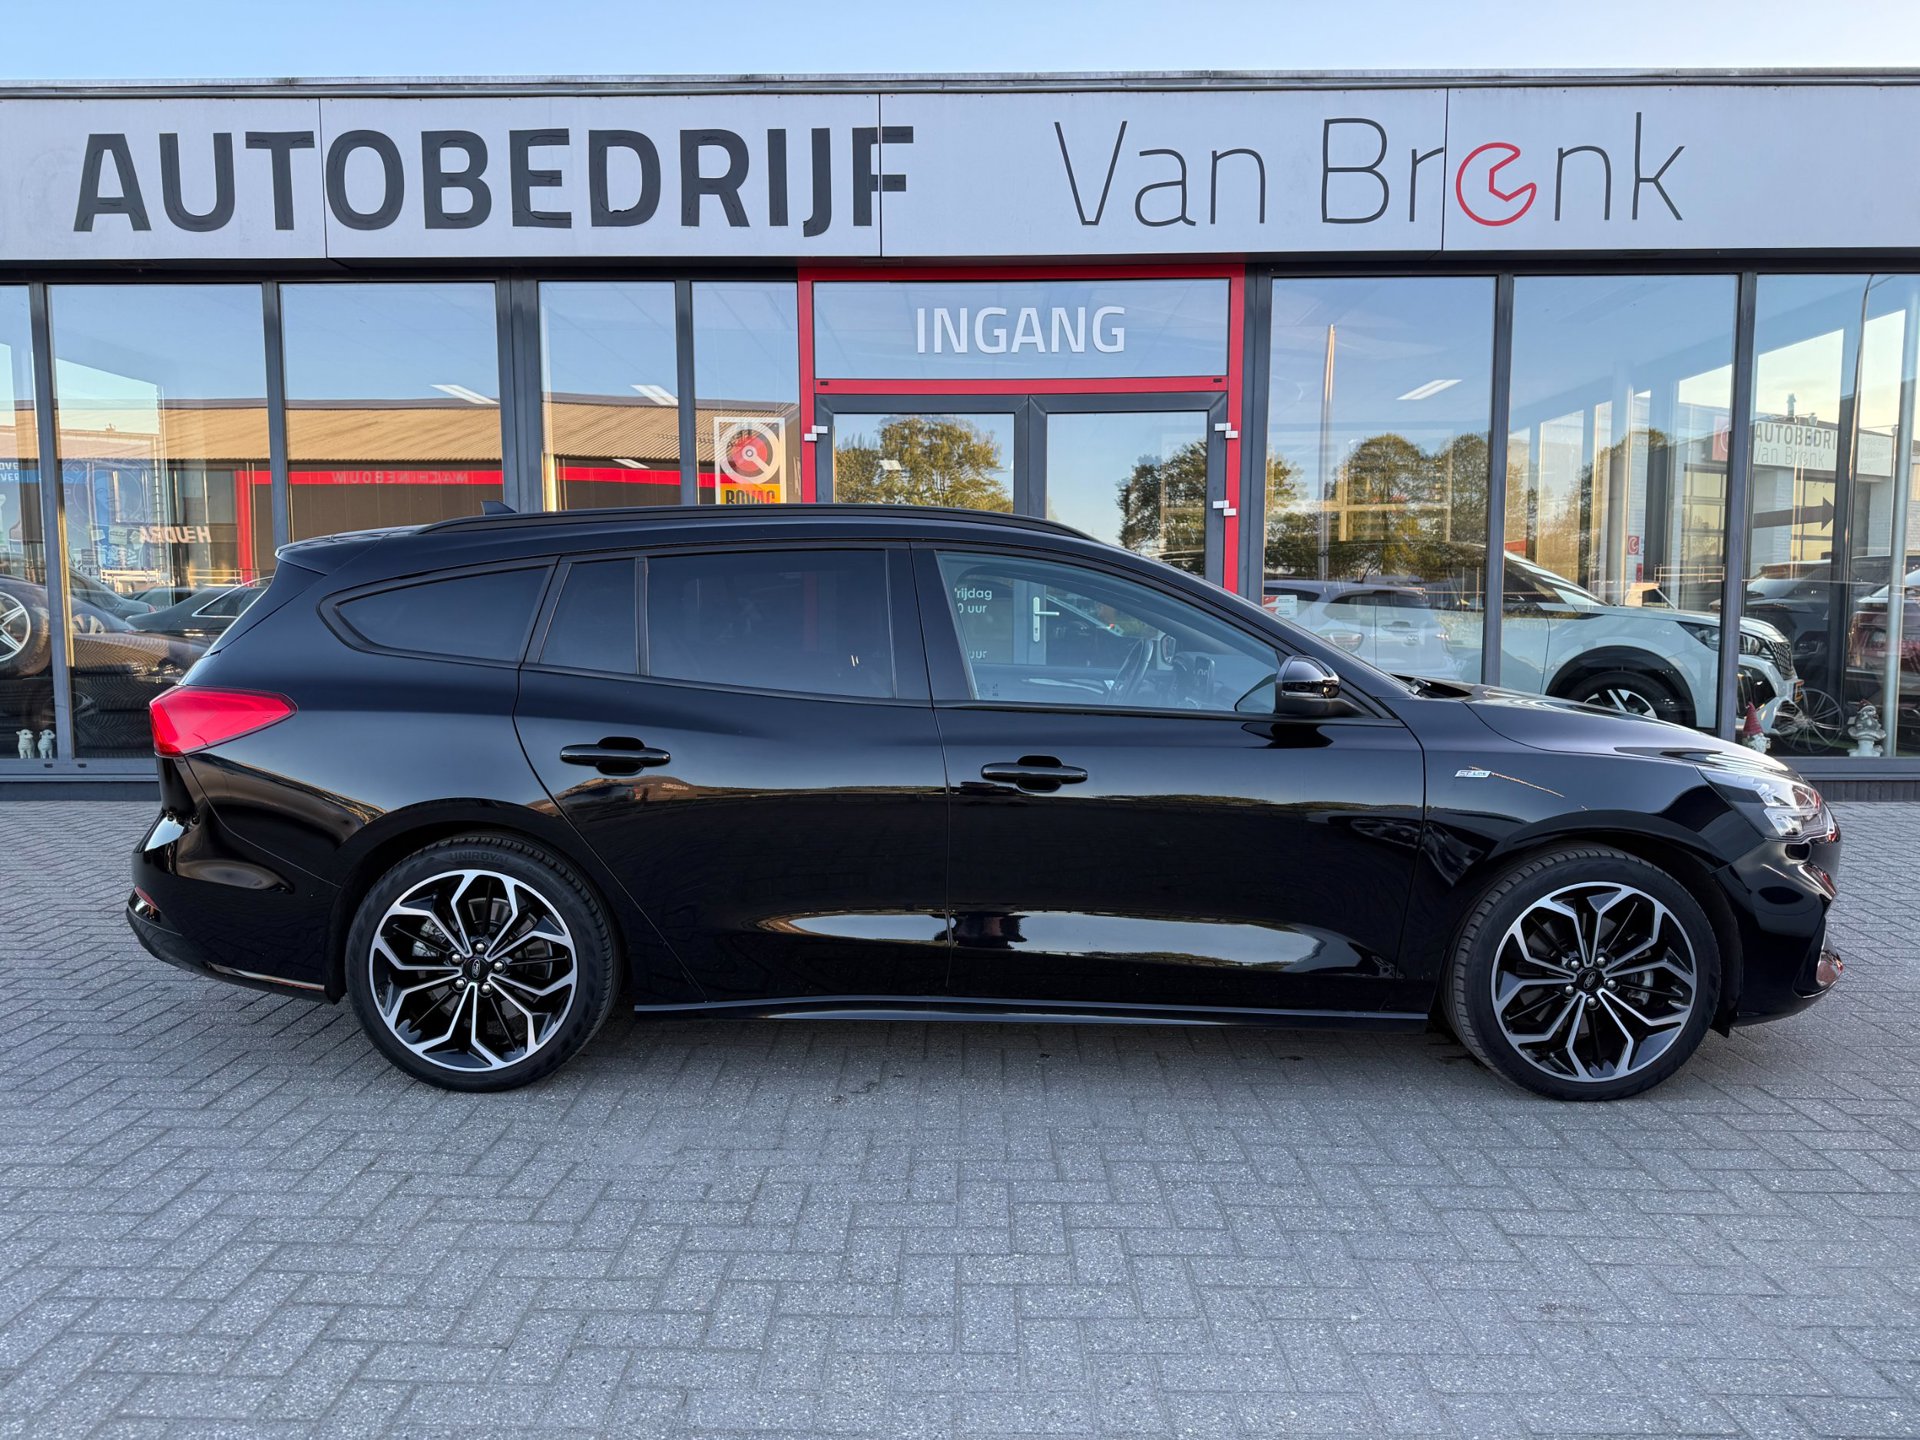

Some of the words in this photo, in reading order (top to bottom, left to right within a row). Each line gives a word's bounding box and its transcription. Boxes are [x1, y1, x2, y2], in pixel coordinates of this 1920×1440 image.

[73, 126, 914, 238] AUTOBEDRIJF
[1053, 120, 1266, 227] Van
[917, 305, 1126, 354] INGANG
[954, 588, 992, 601] rijdag
[968, 605, 987, 613] uur
